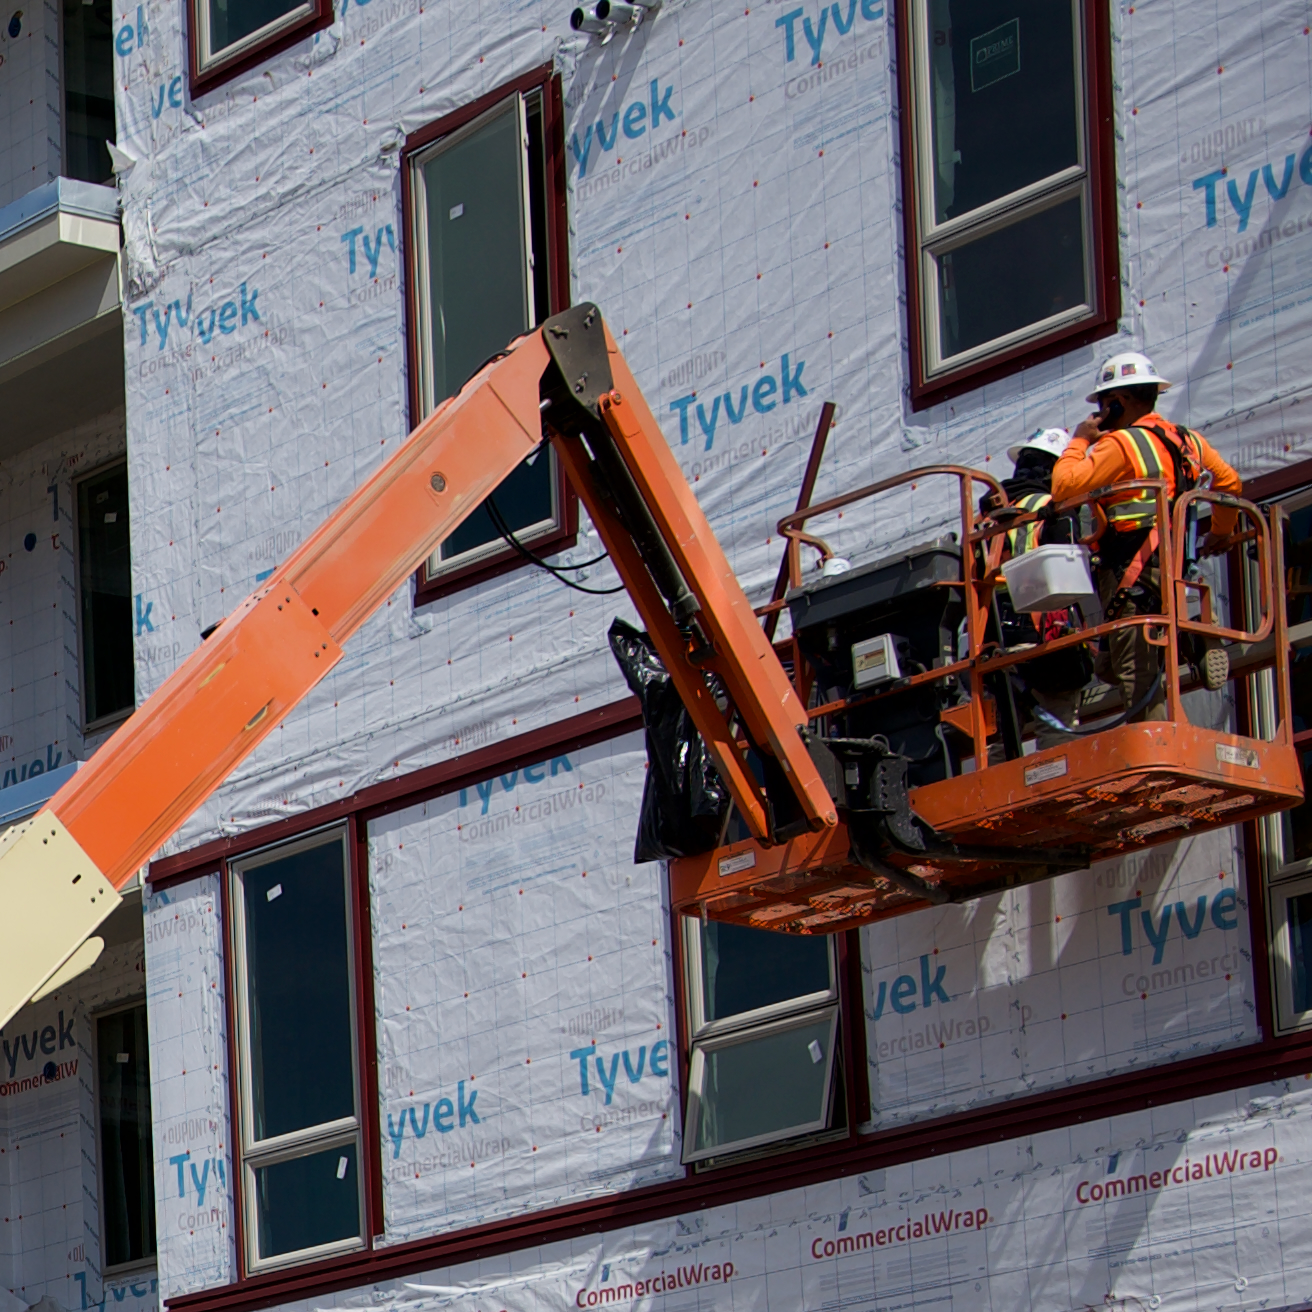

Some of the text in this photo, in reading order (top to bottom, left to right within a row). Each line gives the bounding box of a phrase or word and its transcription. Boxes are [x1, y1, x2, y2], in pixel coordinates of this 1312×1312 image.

[1189, 116, 1257, 165] DUPONT
[667, 350, 721, 389] DUPONT
[669, 353, 809, 452] Tyvek
[459, 779, 607, 842] CommercialWrap
[1075, 1144, 1279, 1205] CommercialWrap
[810, 1205, 990, 1261] CommercialWrap
[575, 1256, 735, 1310] CommercialWrap
